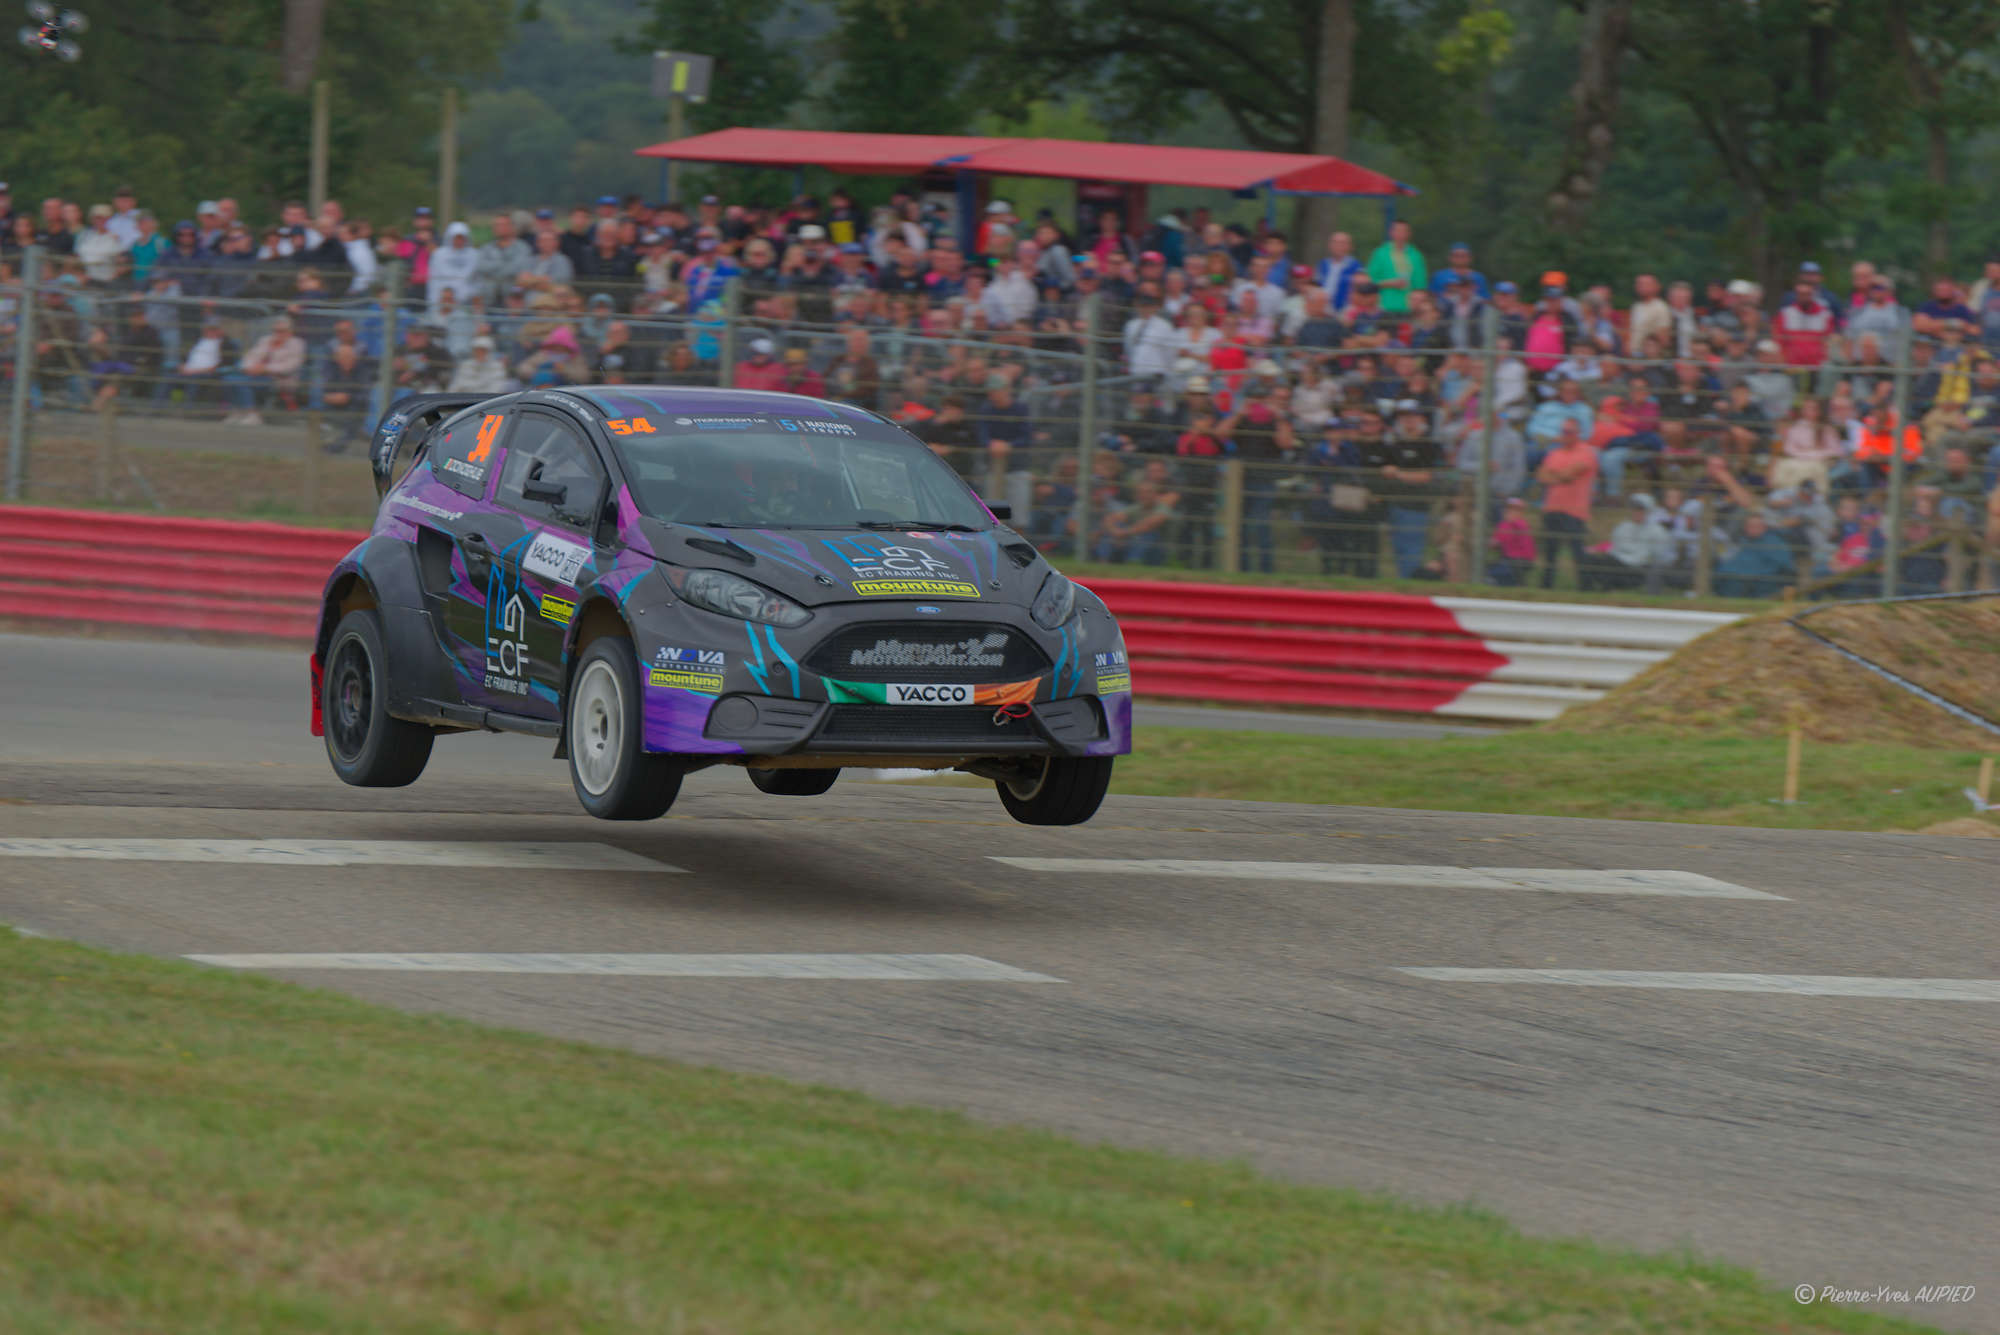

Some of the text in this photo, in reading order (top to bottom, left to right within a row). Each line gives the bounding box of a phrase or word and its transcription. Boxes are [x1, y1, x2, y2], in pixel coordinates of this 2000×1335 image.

[606, 417, 657, 435] 54
[530, 541, 566, 567] YACCO
[879, 568, 935, 578] FRAMING
[858, 581, 974, 594] mountune
[485, 636, 529, 678] ECF
[656, 646, 725, 665] NOVA
[651, 671, 721, 687] mountune
[895, 686, 967, 702] YACCO
